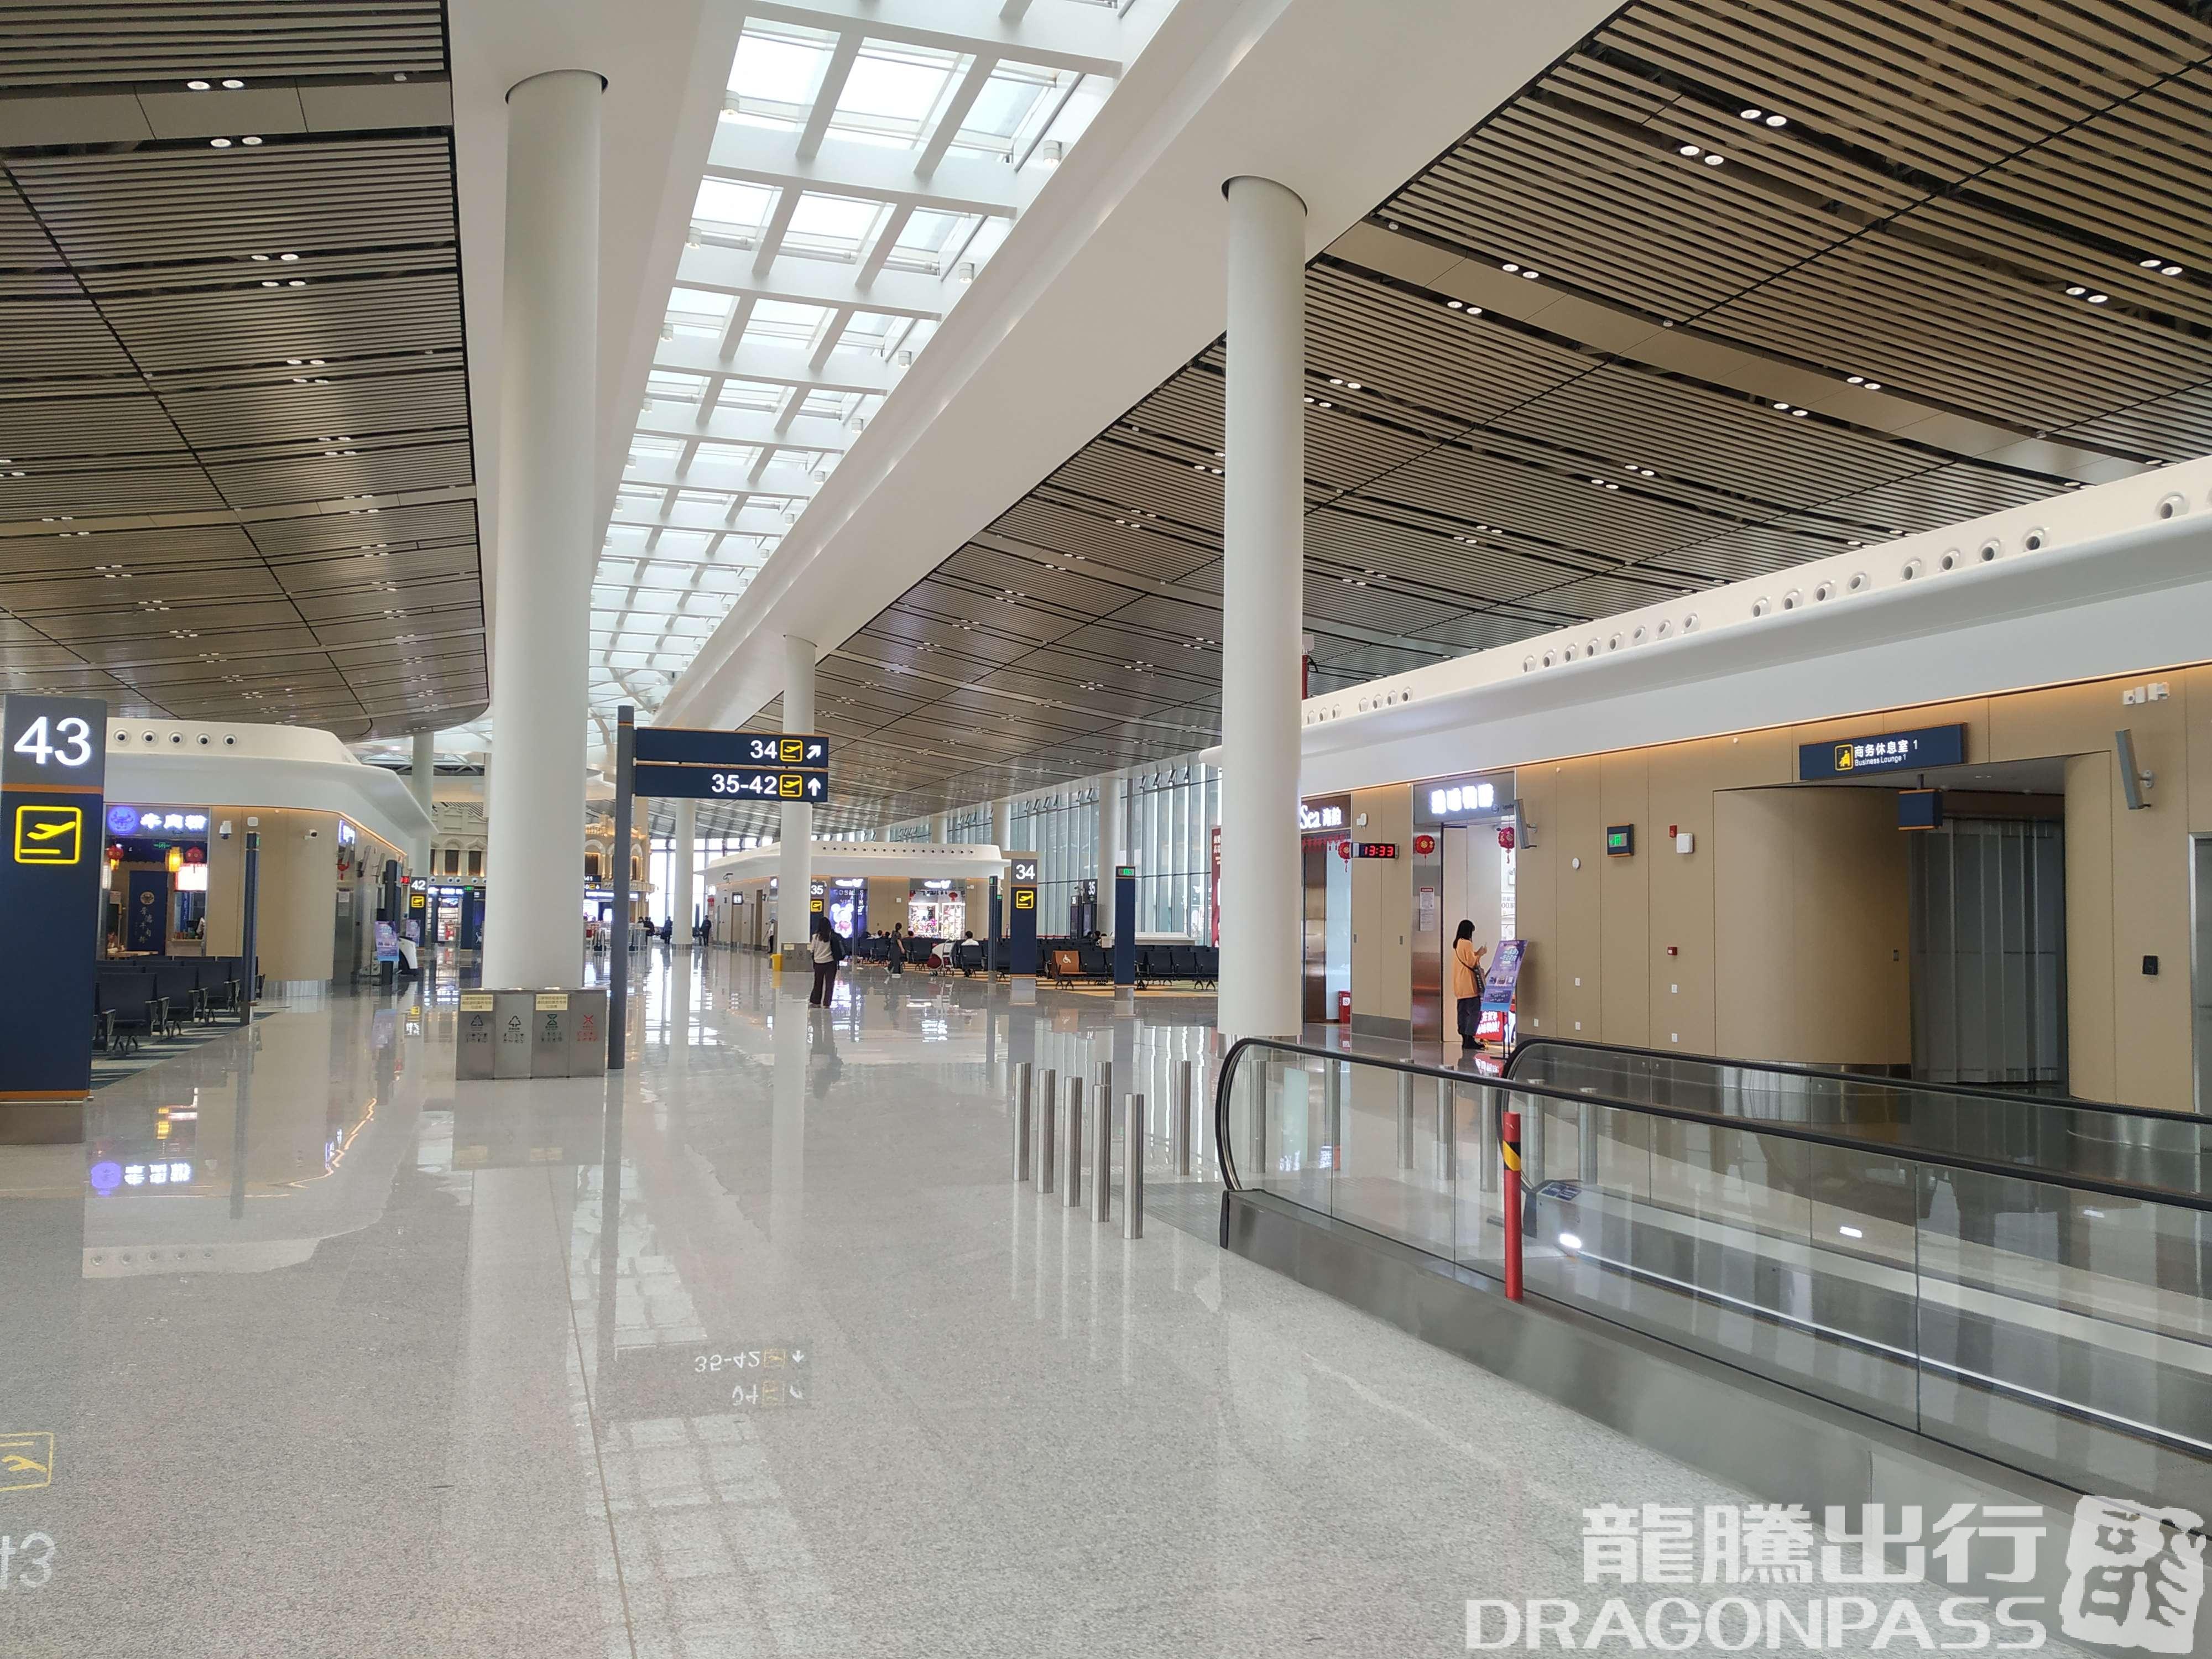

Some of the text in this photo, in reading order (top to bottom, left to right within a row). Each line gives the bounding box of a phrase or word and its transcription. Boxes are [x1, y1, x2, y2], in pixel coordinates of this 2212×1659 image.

[14, 717, 91, 766] 43
[1854, 739, 1918, 758] 商务休息室 1
[750, 740, 778, 759] 34
[1855, 758, 1880, 766] Business
[711, 774, 777, 794] 35-42
[1364, 846, 1394, 857] 13:33
[1015, 864, 1035, 880] 34
[411, 880, 426, 890] 42
[810, 885, 823, 895] 35
[1088, 881, 1095, 895] 35
